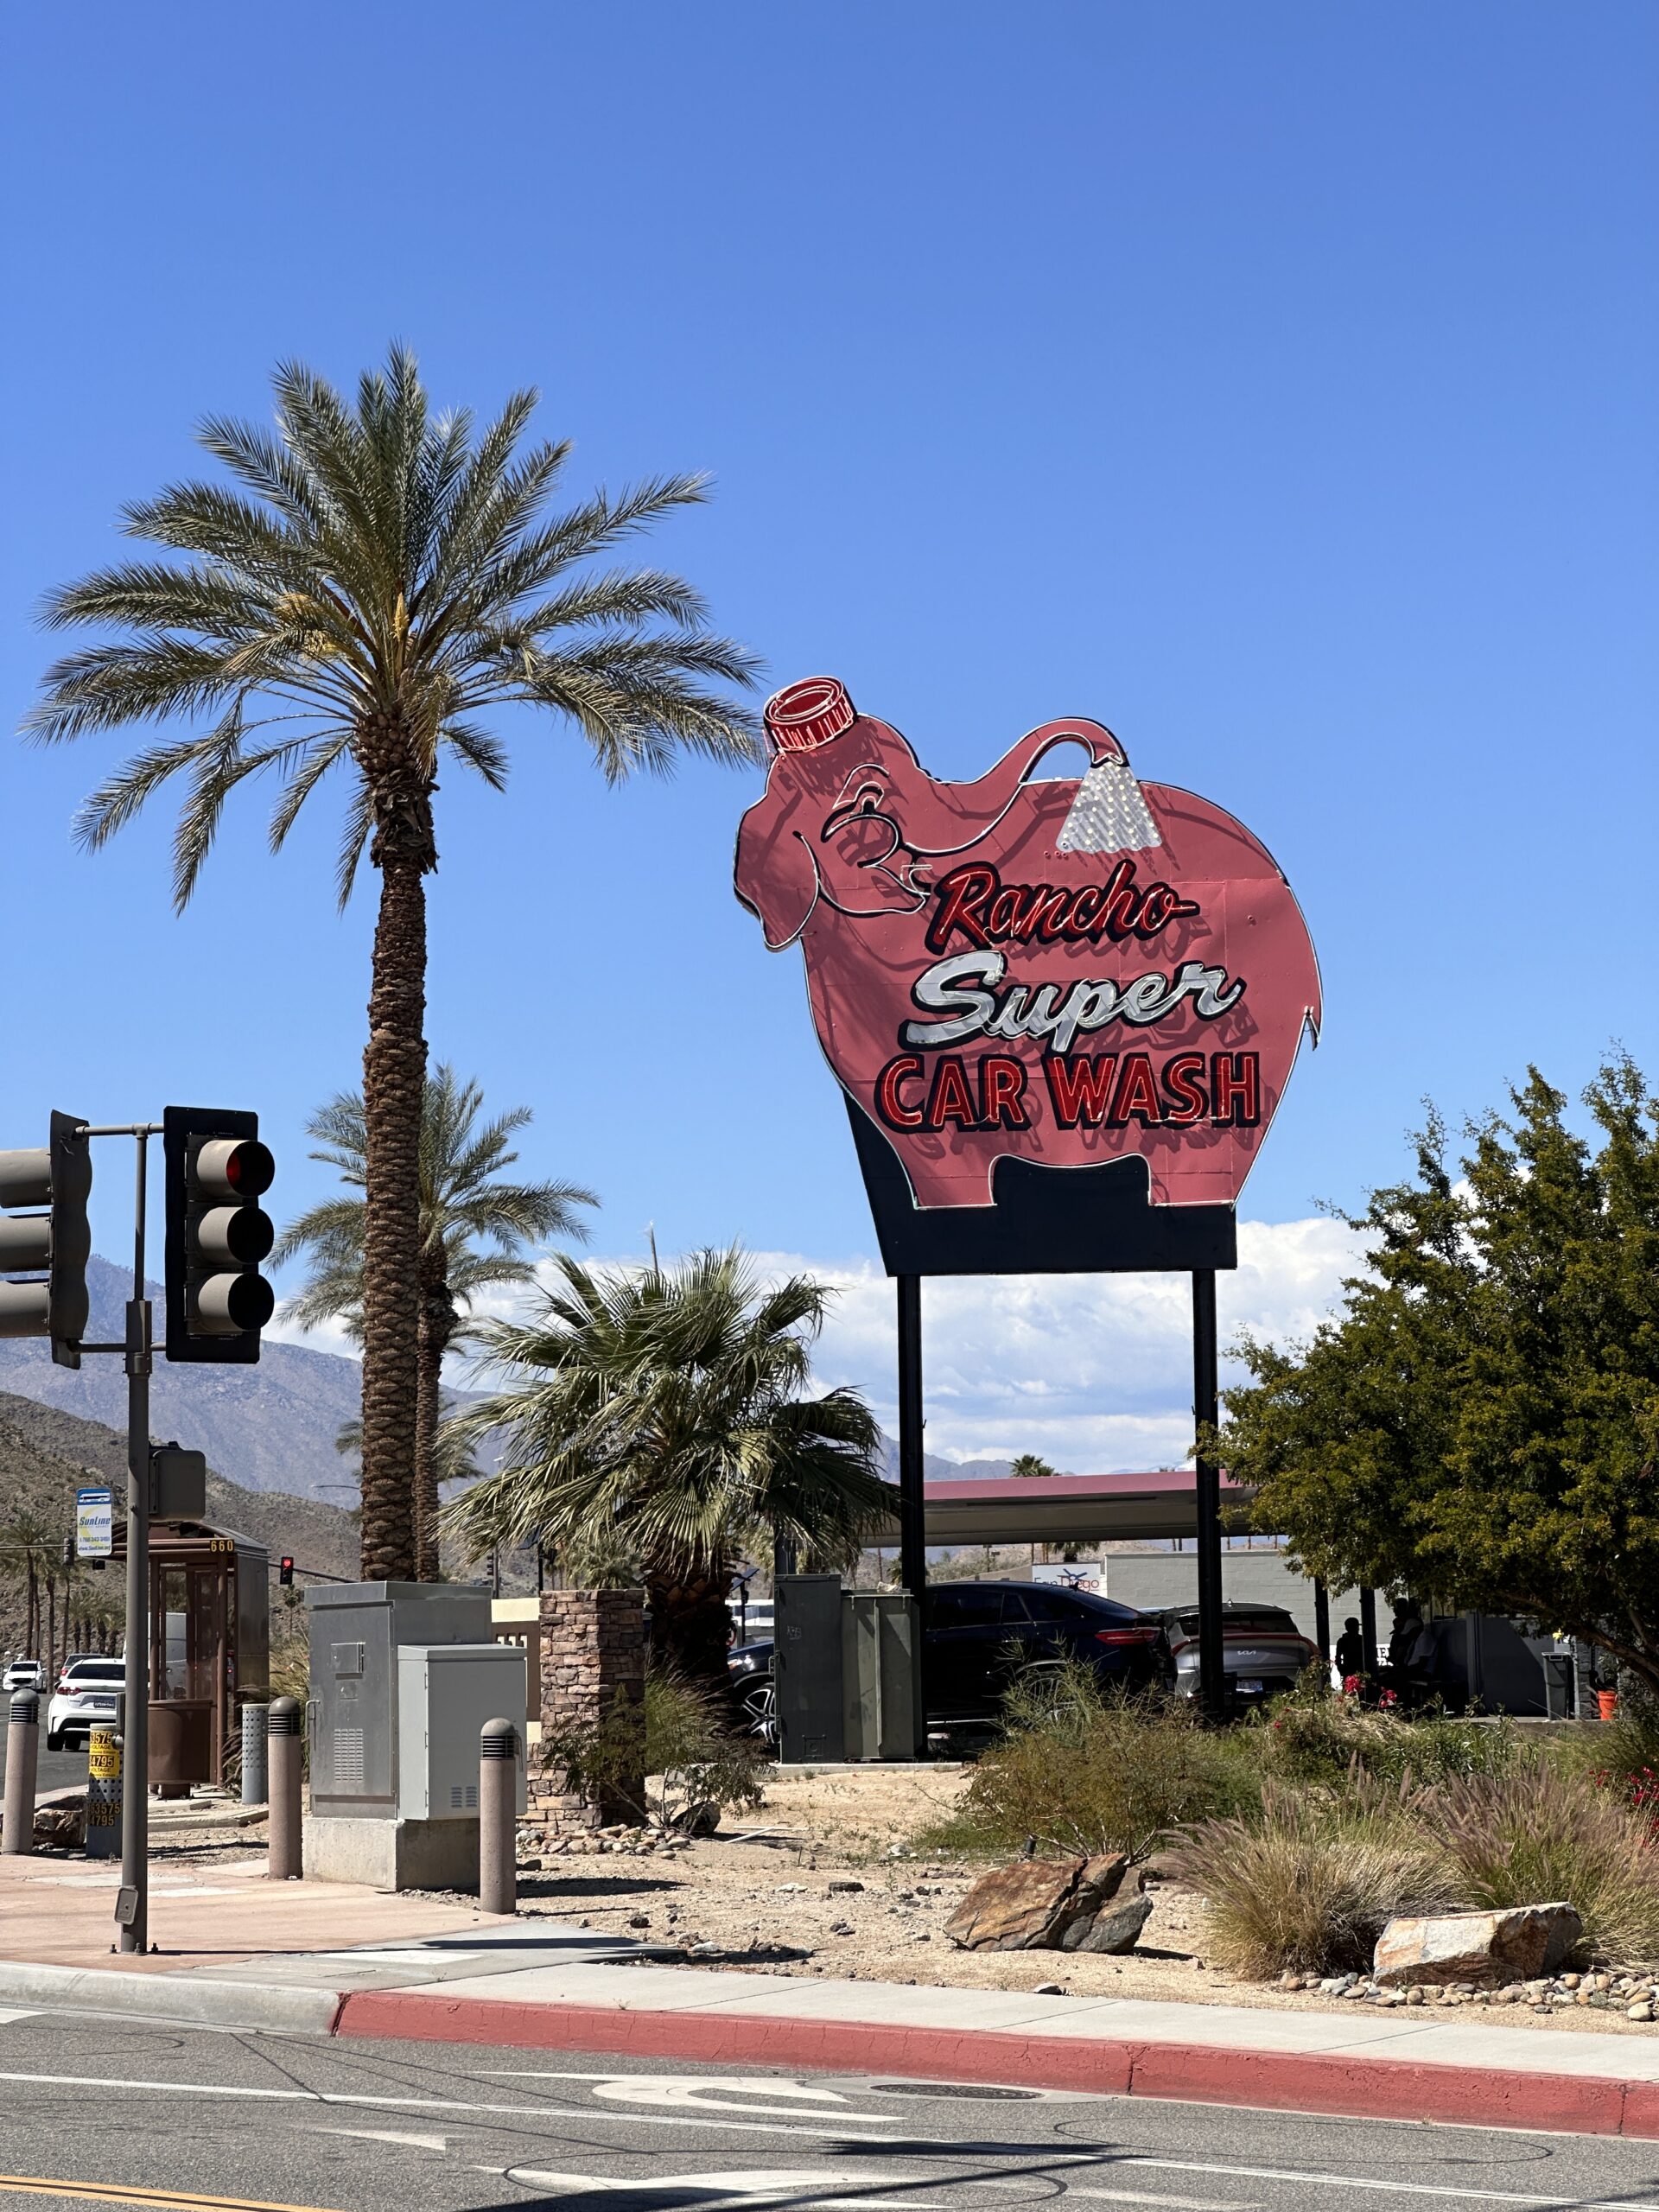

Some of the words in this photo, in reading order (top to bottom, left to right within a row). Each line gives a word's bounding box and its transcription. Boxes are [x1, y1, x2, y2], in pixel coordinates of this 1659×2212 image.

[926, 860, 1198, 953] Rancho
[904, 950, 1243, 1052] Super
[876, 1054, 1029, 1128] CAR
[1046, 1053, 1259, 1128] WASH
[211, 1540, 233, 1552] 660
[1059, 1577, 1100, 1592] Dego
